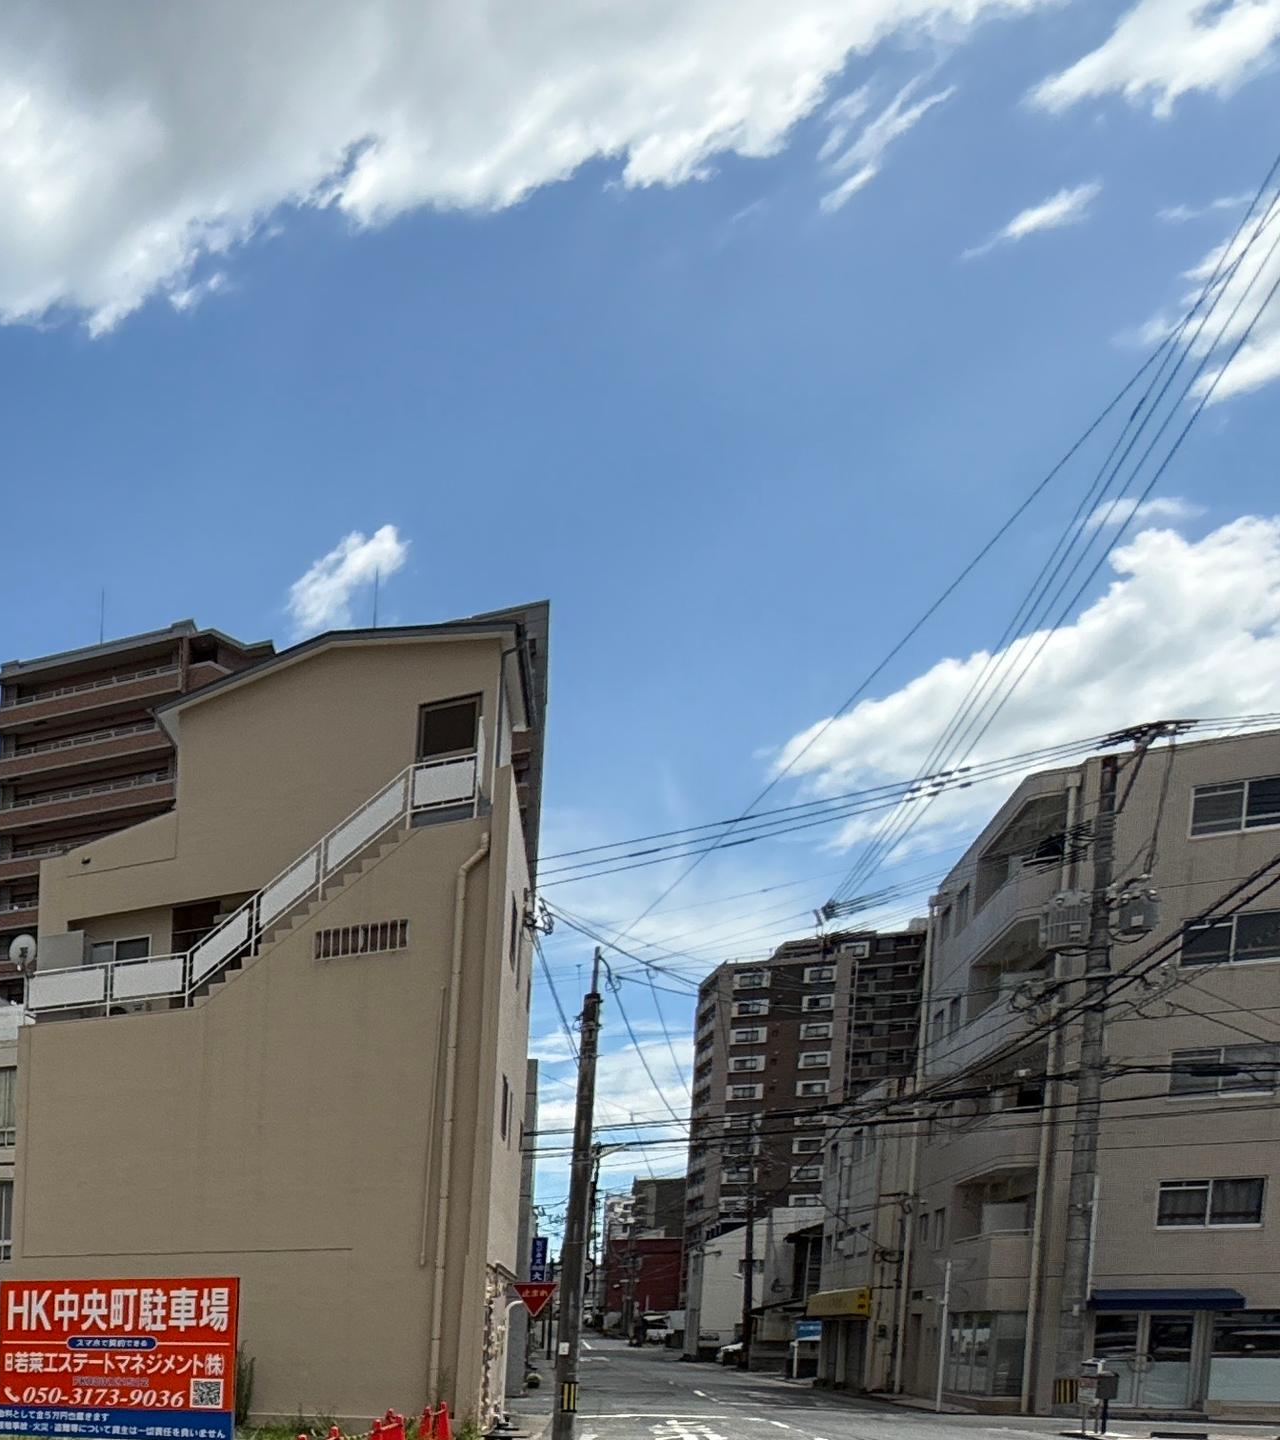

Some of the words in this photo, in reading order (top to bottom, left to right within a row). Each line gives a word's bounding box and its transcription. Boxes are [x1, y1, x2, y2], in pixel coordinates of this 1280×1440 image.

[7, 1287, 229, 1332] HK中央町駐車場
[22, 1386, 186, 1408] 050-3173-9036
